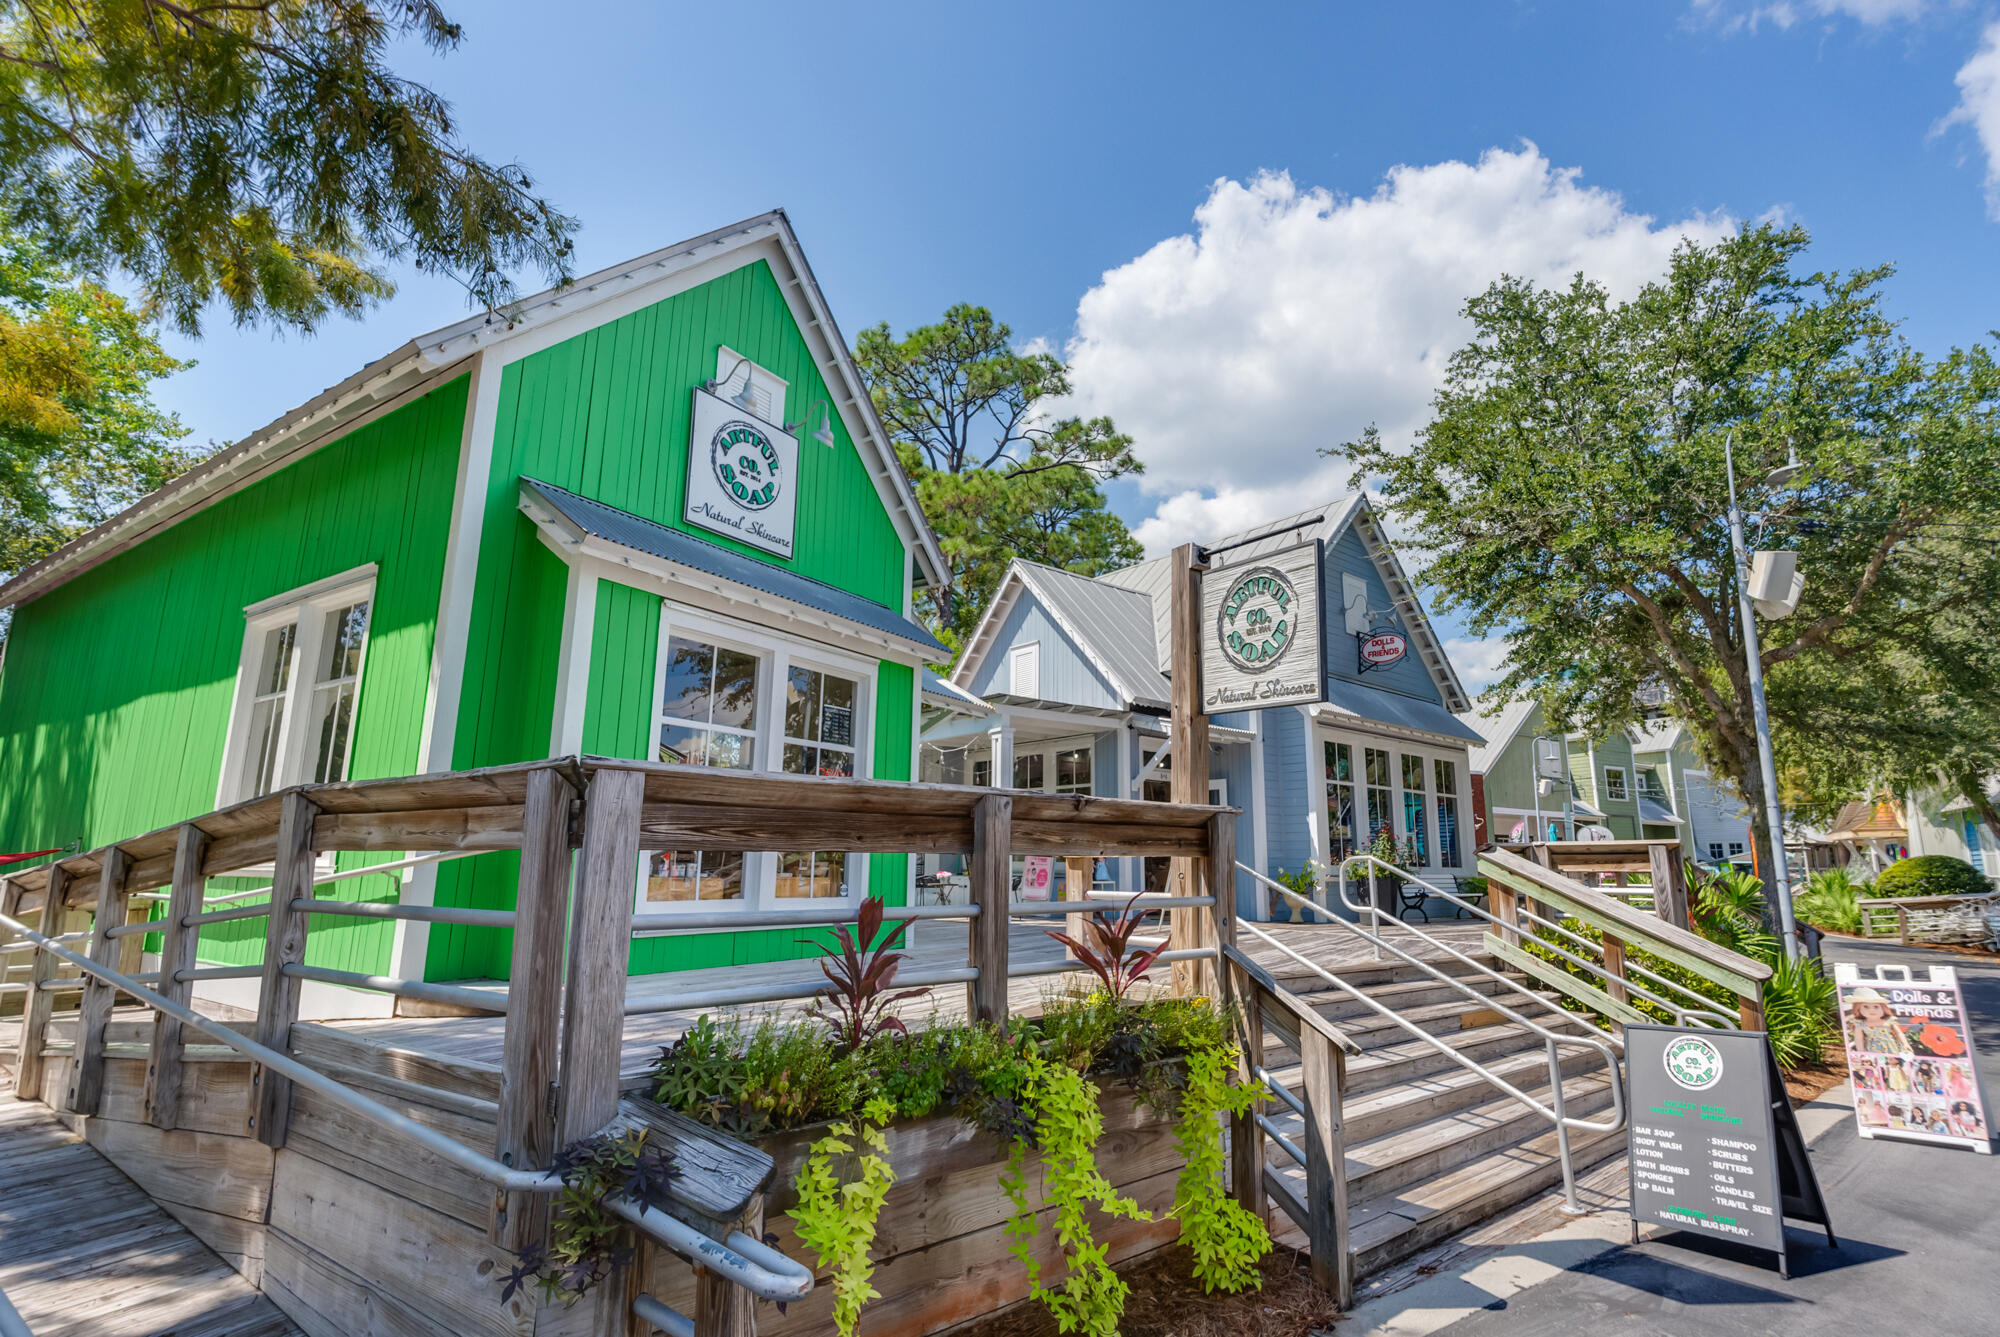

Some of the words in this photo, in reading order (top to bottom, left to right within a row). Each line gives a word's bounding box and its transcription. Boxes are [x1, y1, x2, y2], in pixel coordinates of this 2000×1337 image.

[719, 428, 780, 477] ARTFUL
[739, 455, 761, 476] CO.
[719, 463, 775, 506] SOAP
[690, 502, 746, 530] Natural
[745, 522, 791, 548] Skincare
[1224, 576, 1292, 627] ARTFUL
[1246, 608, 1272, 626] CO.
[1226, 620, 1288, 662] SOAP
[1372, 638, 1395, 647] DOLLS
[1368, 648, 1400, 658] FRIENDS
[1206, 682, 1259, 706] Natural
[1260, 678, 1316, 700] Skincare
[1892, 990, 1932, 1004] Dolls
[1936, 992, 1952, 1005] &
[1896, 1006, 1954, 1019] Friends
[1672, 1042, 1715, 1064] ARTFUL
[1672, 1064, 1713, 1083] SOAP
[1636, 1126, 1651, 1135] BAR
[1654, 1129, 1675, 1138] SOAP
[1636, 1136, 1656, 1146] BODY
[1659, 1140, 1682, 1151] WASH
[1712, 1138, 1757, 1152] SHAMPOO
[1636, 1148, 1664, 1159] LOTION
[1712, 1149, 1748, 1162] SCRUBS
[1636, 1160, 1656, 1170] BATH
[1660, 1164, 1690, 1176] BOMBS
[1712, 1161, 1754, 1175] BUTTERS
[1638, 1170, 1674, 1184] SPONGES
[1714, 1174, 1735, 1184] OILS
[1638, 1182, 1650, 1190] LIP
[1652, 1184, 1675, 1196] BALM
[1714, 1184, 1756, 1199] CANDLES
[1715, 1196, 1750, 1211] TRAVEL
[1752, 1204, 1774, 1216] SIZE
[1660, 1210, 1698, 1226] NATURAL
[1701, 1219, 1719, 1230] BUG
[1720, 1224, 1750, 1236] SPRAY
